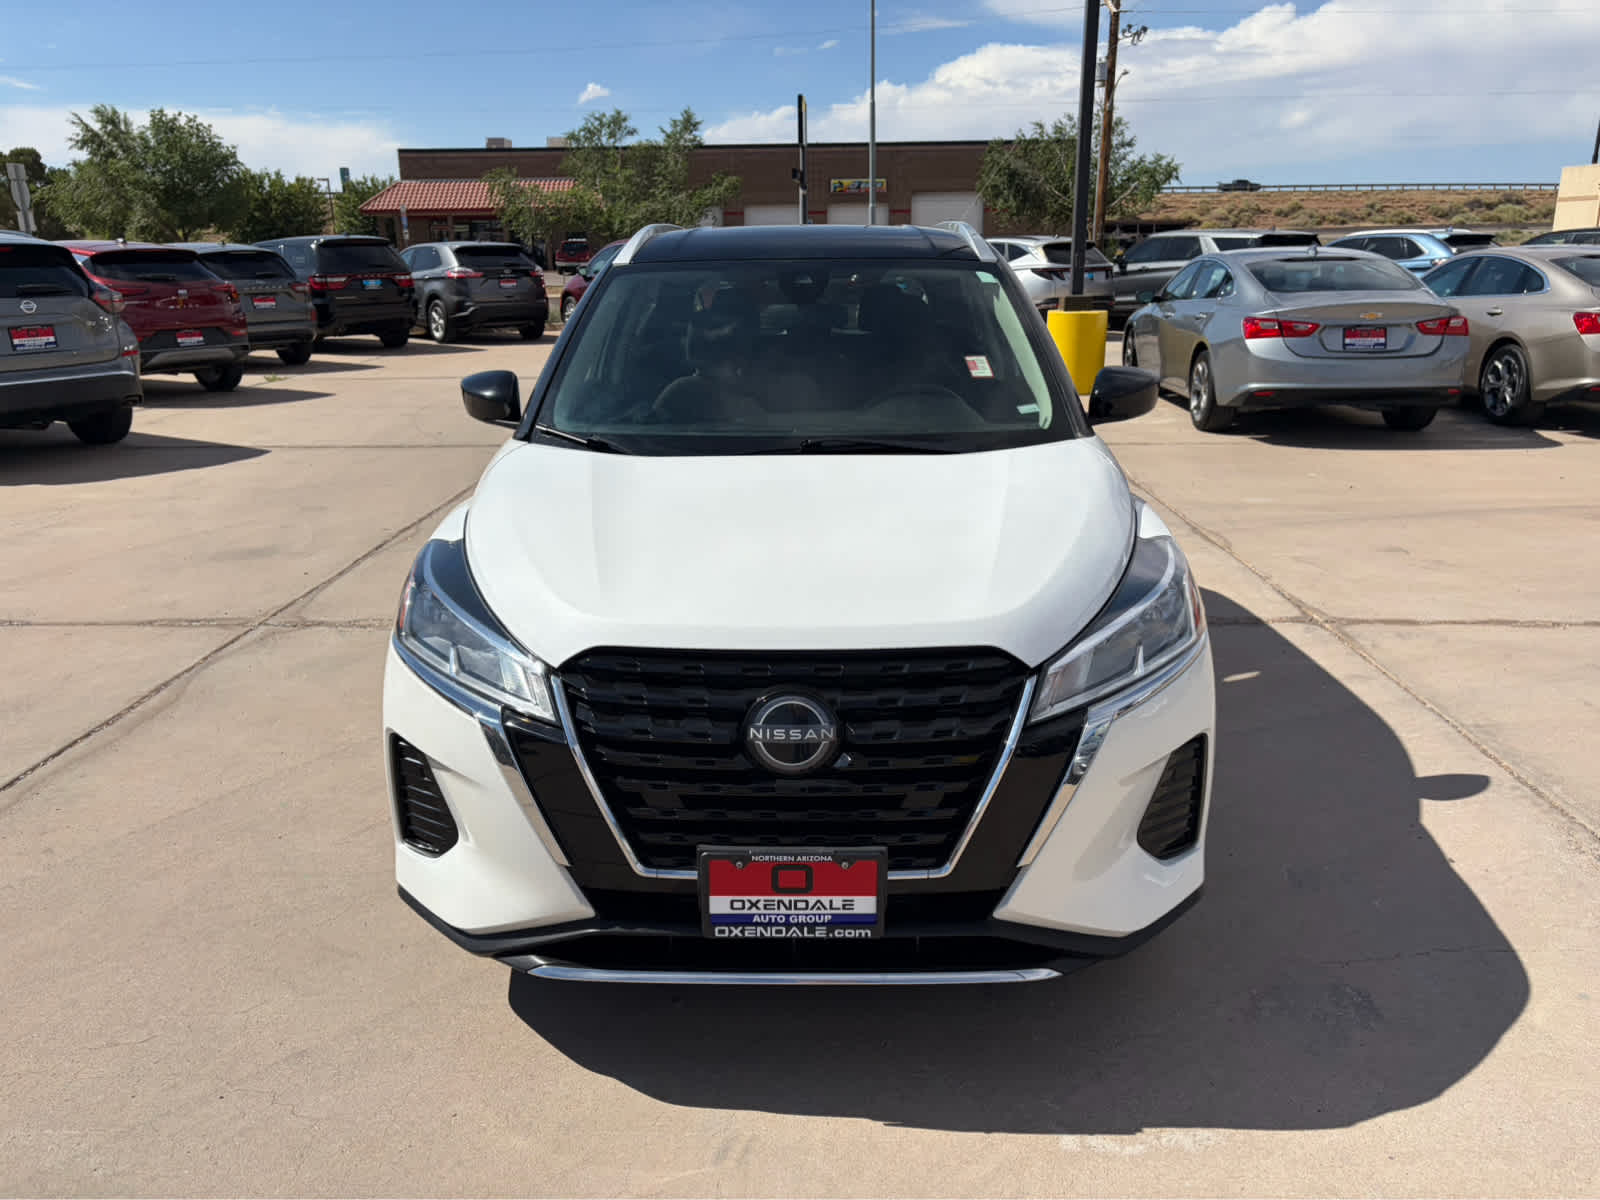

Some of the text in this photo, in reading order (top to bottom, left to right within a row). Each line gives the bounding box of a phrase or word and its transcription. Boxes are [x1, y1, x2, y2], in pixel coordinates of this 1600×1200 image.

[750, 727, 834, 740] NISSAN
[729, 899, 855, 911] OXENDALE
[752, 914, 832, 923] AUTO GROUP
[714, 926, 872, 938] OXENDALE.com
